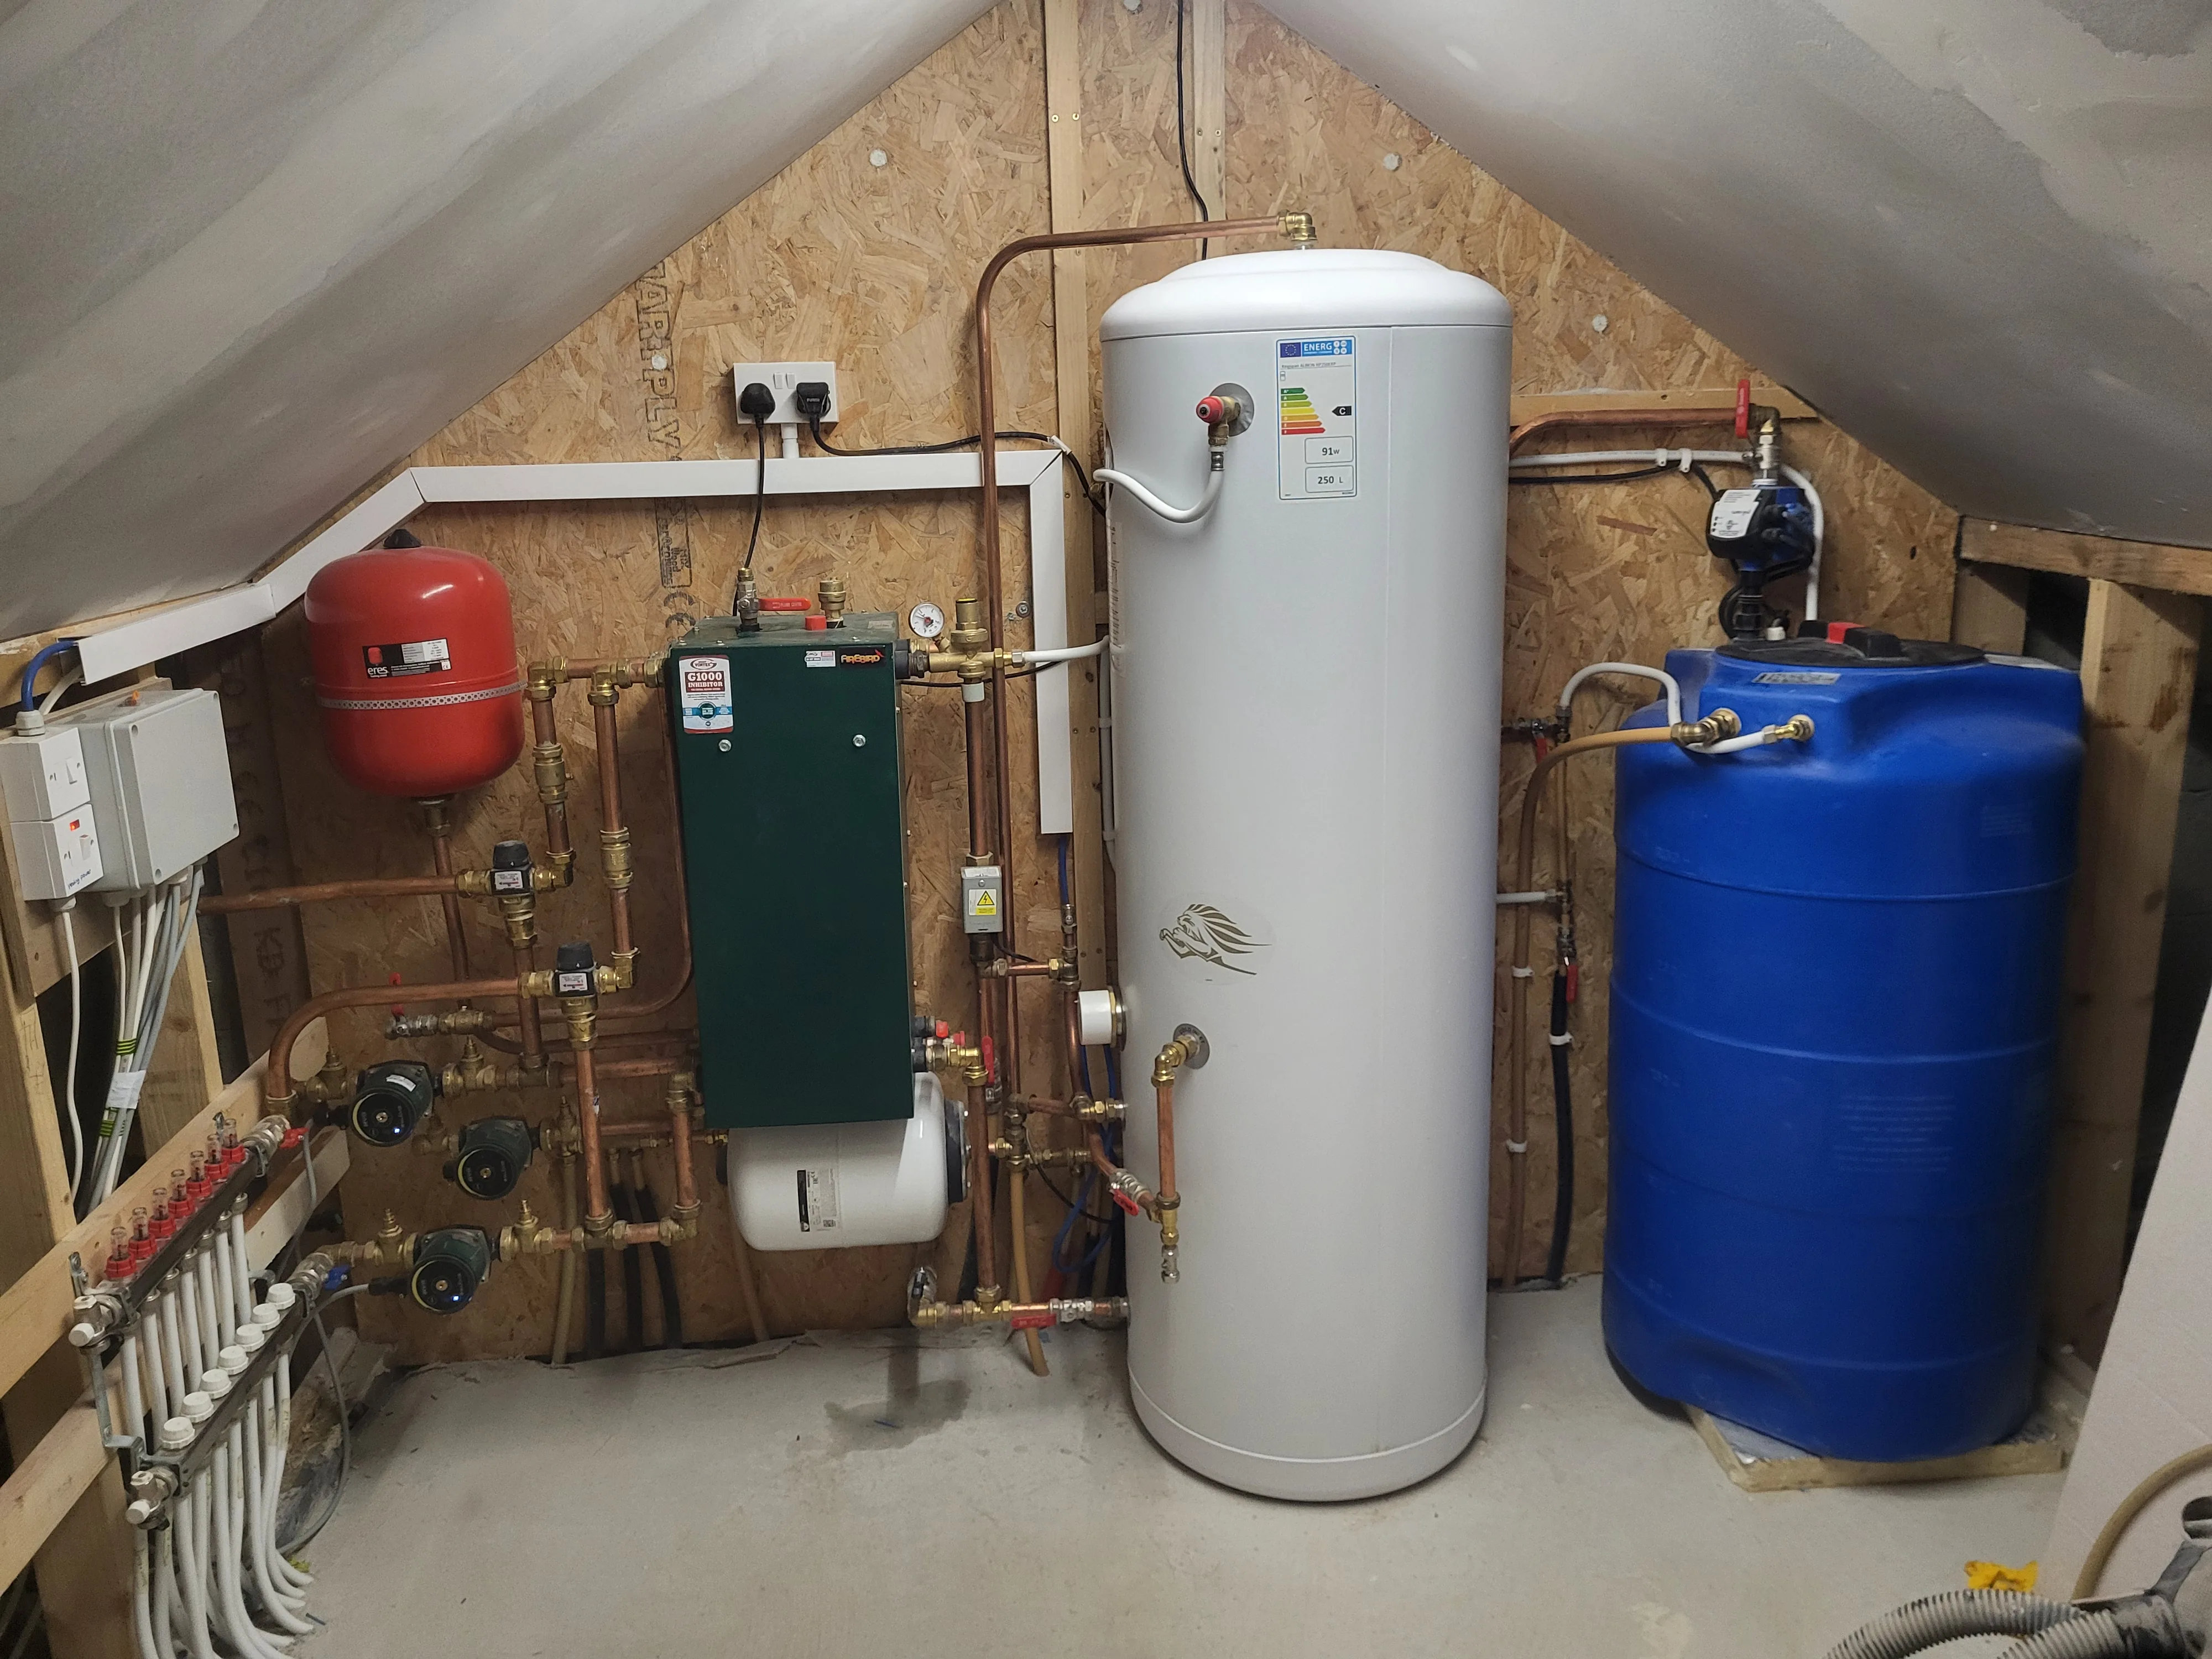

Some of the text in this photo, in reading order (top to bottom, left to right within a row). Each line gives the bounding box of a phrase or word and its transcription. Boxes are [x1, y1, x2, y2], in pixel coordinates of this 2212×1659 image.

[1303, 342, 1332, 352] ENERG
[1318, 476, 1334, 484] 250
[841, 654, 880, 664] FIREBIRD
[367, 666, 388, 675] eres
[687, 672, 722, 681] G1000
